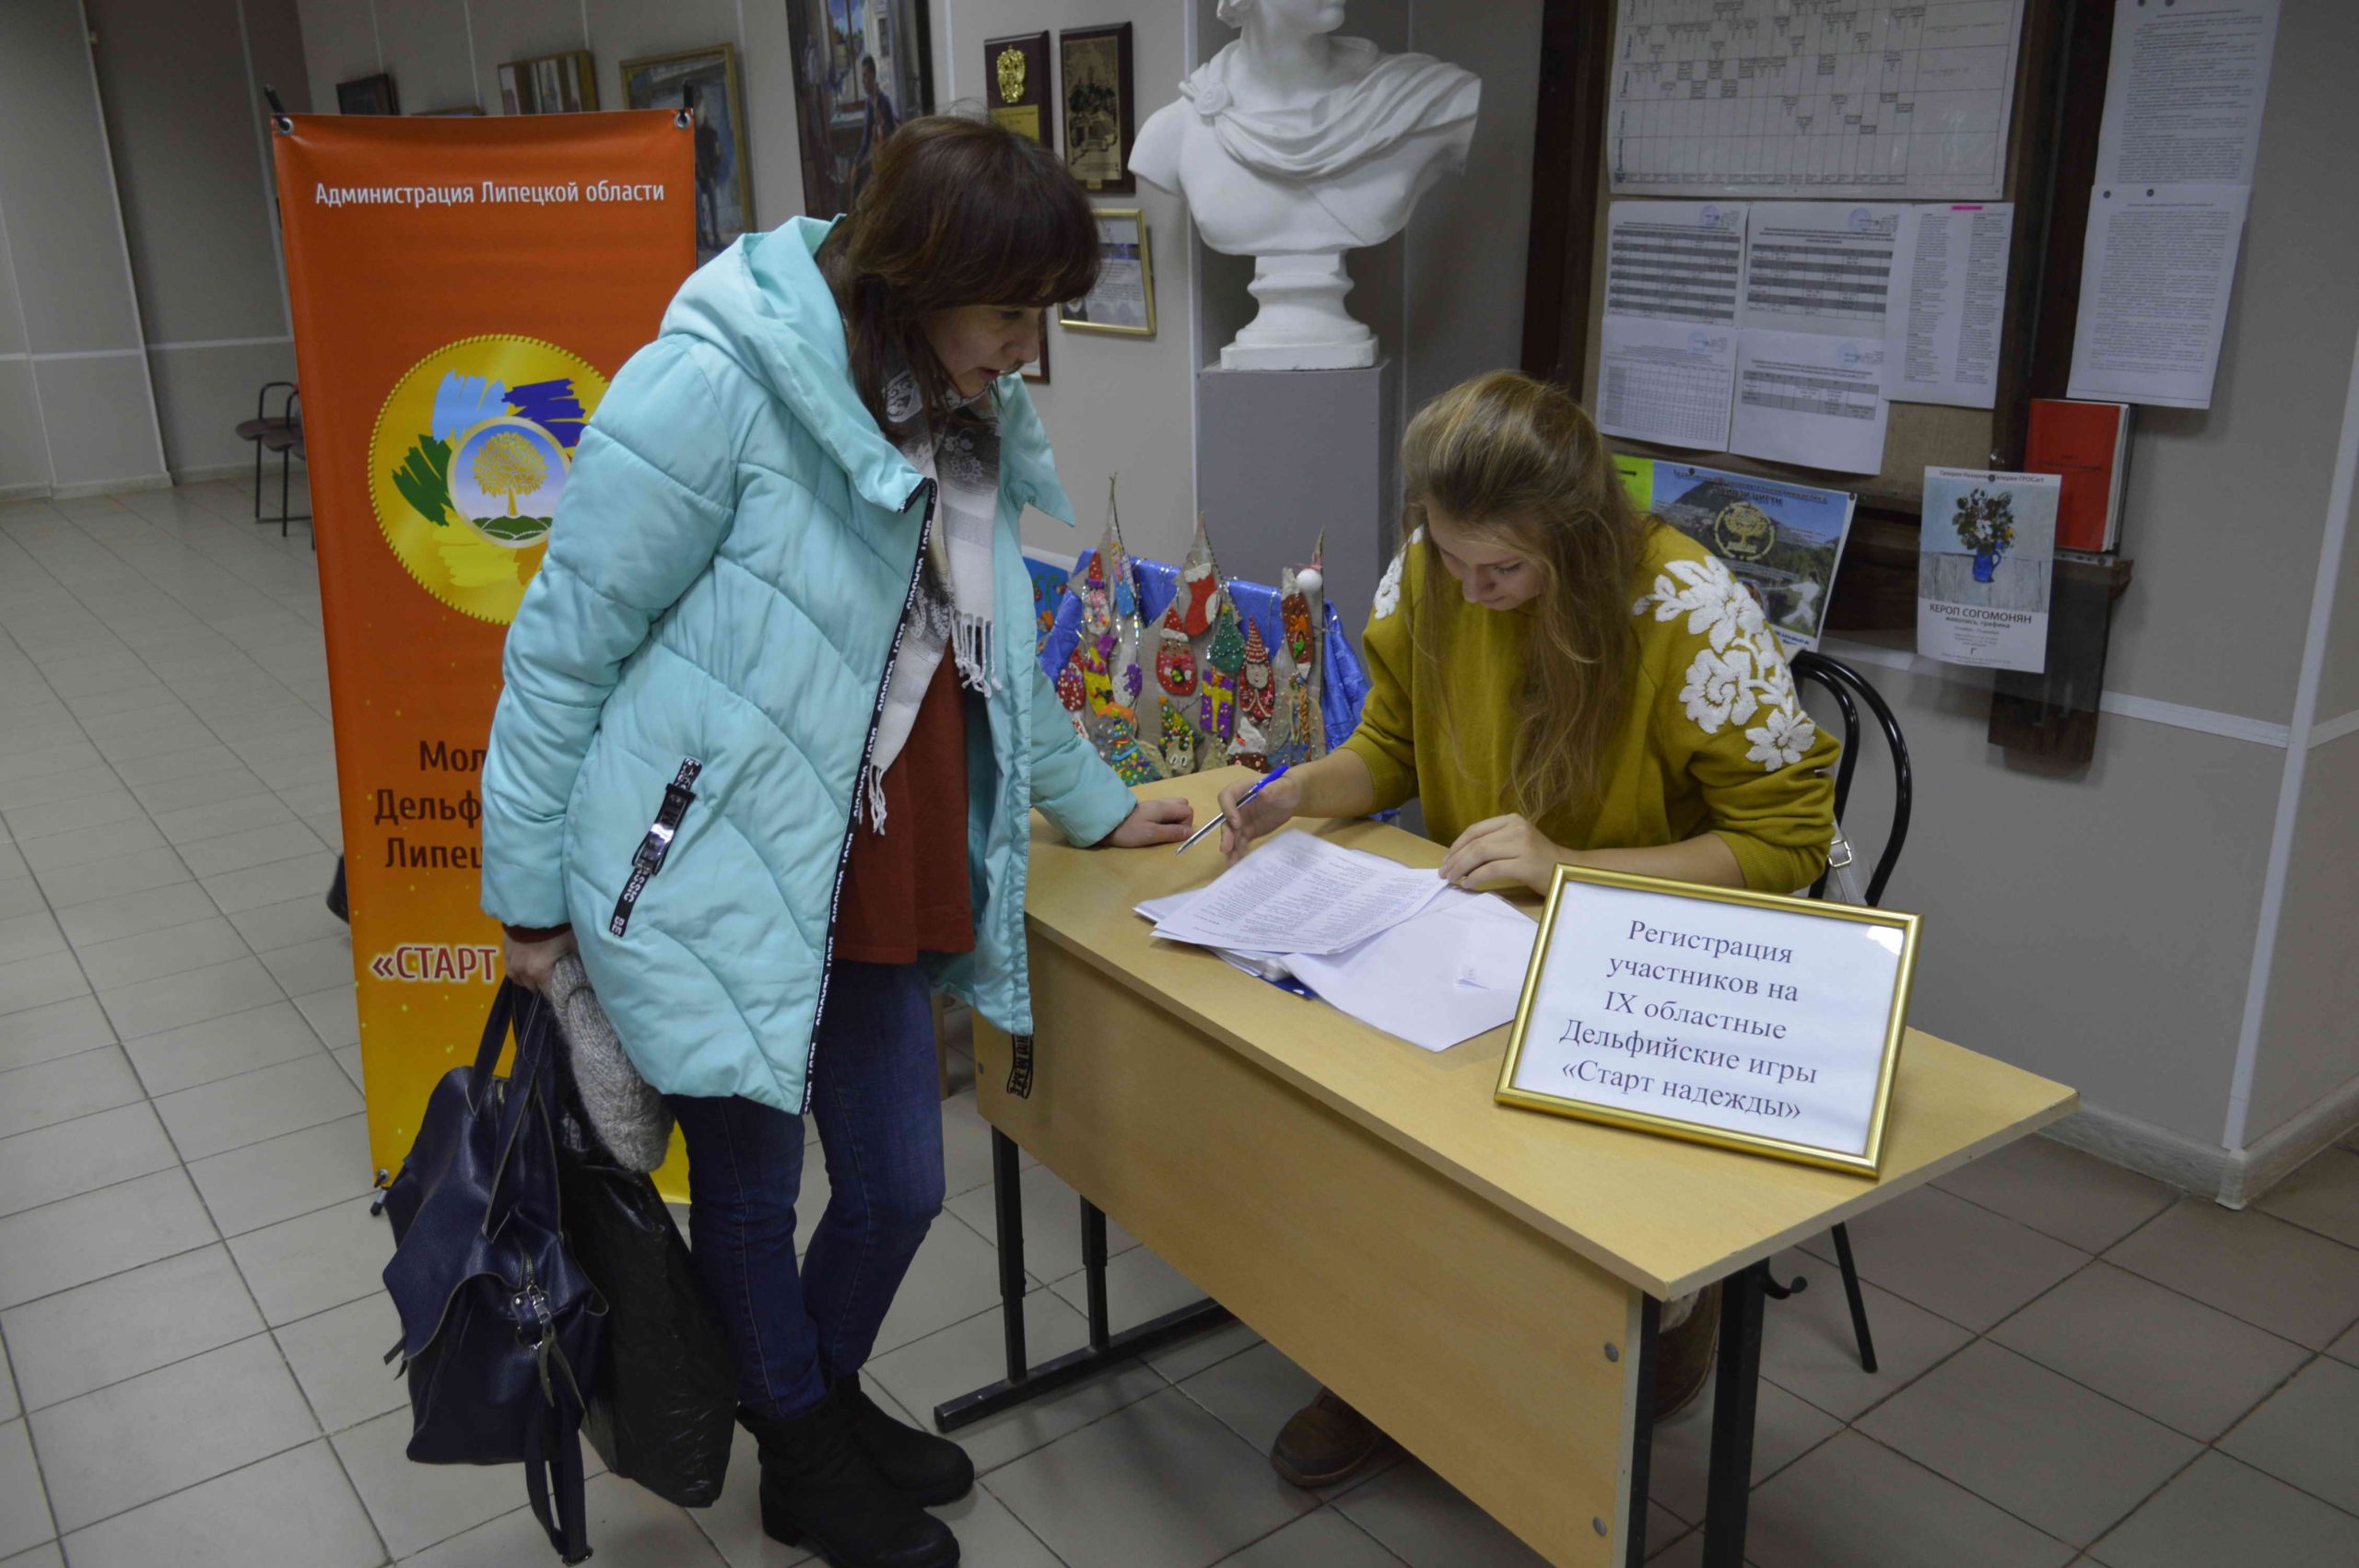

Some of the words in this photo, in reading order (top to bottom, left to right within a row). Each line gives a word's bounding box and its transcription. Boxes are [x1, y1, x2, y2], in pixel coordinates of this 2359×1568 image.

[315, 182, 474, 208] Администрация
[481, 180, 579, 206] Липецкой
[586, 179, 664, 203] области
[1930, 603, 1960, 616] КЕРОП
[1963, 608, 2032, 625] СОГОМОНЯН
[374, 788, 483, 828] Дельф
[370, 943, 499, 983] «СТАРТ
[1627, 919, 1793, 965] Регистрация
[1606, 957, 1758, 996] участников
[1768, 982, 1799, 1001] на
[1604, 991, 1637, 1014] IX
[1644, 1000, 1787, 1039] областные
[1559, 1019, 1740, 1070] Дельфийские
[1749, 1059, 1817, 1085] игры
[1562, 1059, 1655, 1095] «Старт
[1662, 1080, 1801, 1119] надежды»
